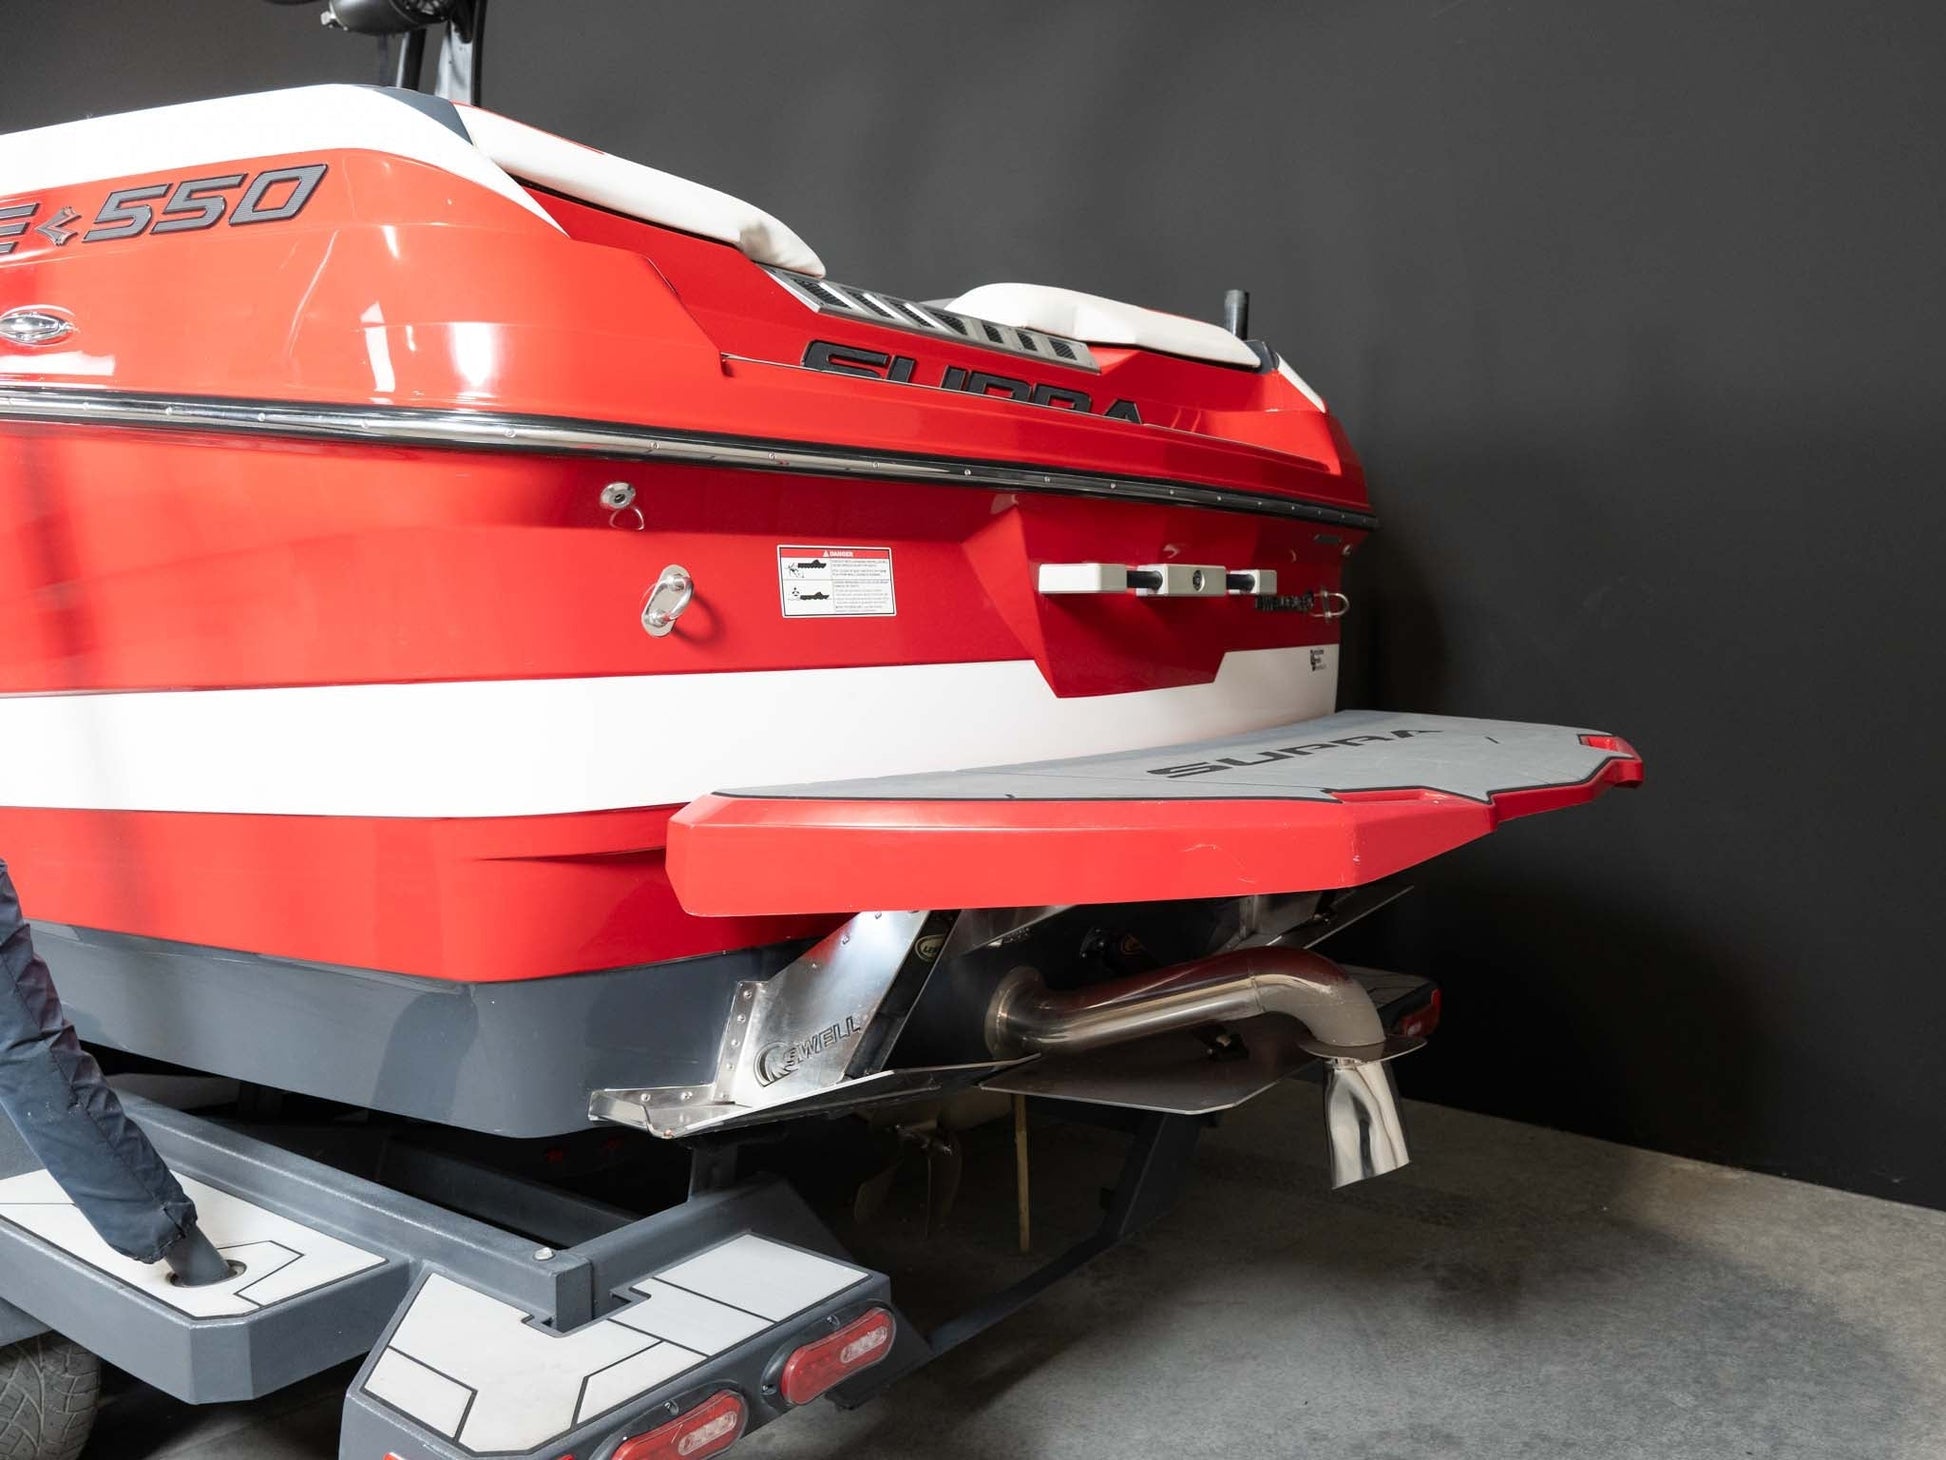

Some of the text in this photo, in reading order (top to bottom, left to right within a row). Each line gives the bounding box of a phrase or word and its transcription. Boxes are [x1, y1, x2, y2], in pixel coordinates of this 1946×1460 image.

[82, 163, 329, 243] 550
[829, 550, 854, 558] DANGER
[1147, 729, 1445, 779] SUPRA
[783, 1015, 861, 1066] SWELL
